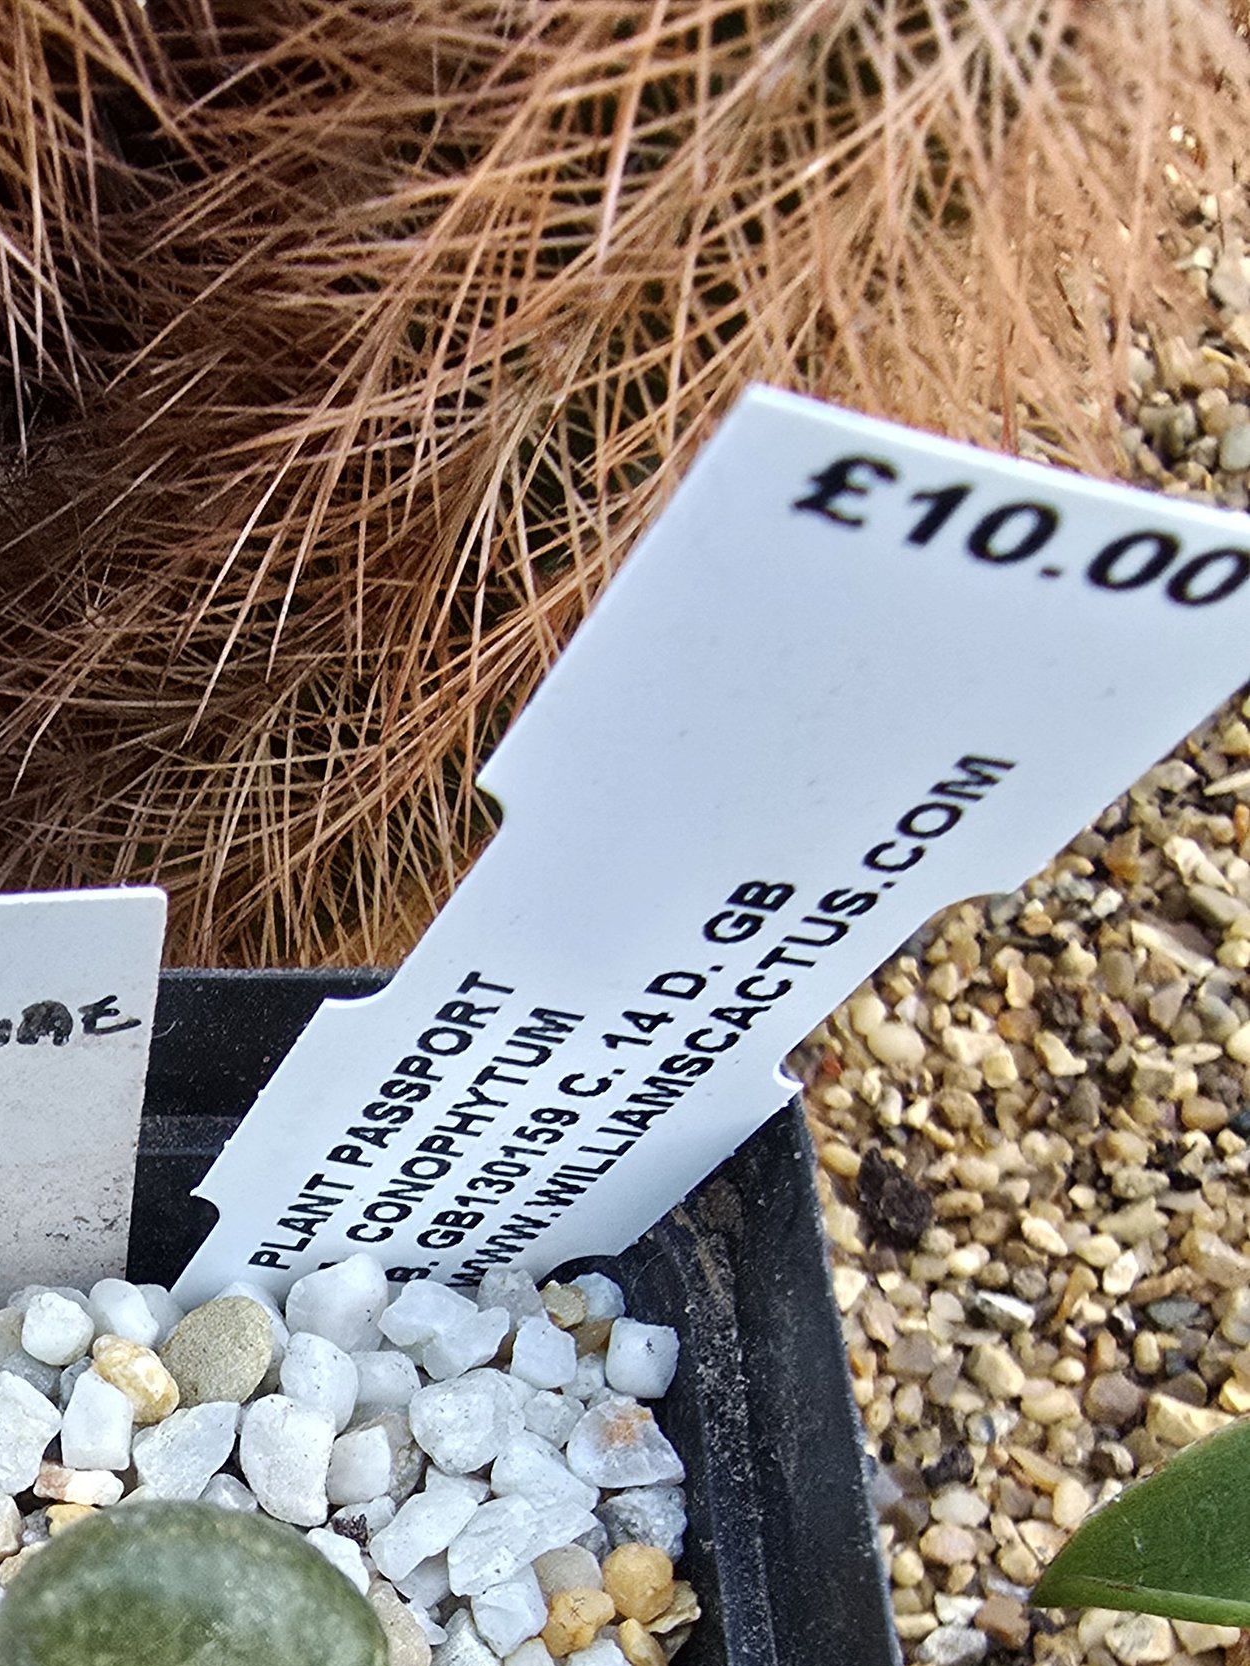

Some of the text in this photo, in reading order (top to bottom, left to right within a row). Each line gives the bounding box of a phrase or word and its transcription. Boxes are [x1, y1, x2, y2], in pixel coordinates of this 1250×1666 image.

[791, 453, 1250, 606] £10.00
[248, 970, 515, 1269] PLANT PASSPORT
[346, 1007, 585, 1242] CONOPHYTUM
[416, 1107, 580, 1249] GB130159
[558, 1067, 627, 1098] C.
[602, 1009, 675, 1046] 14
[644, 965, 726, 1001] D.
[703, 880, 796, 944] GB
